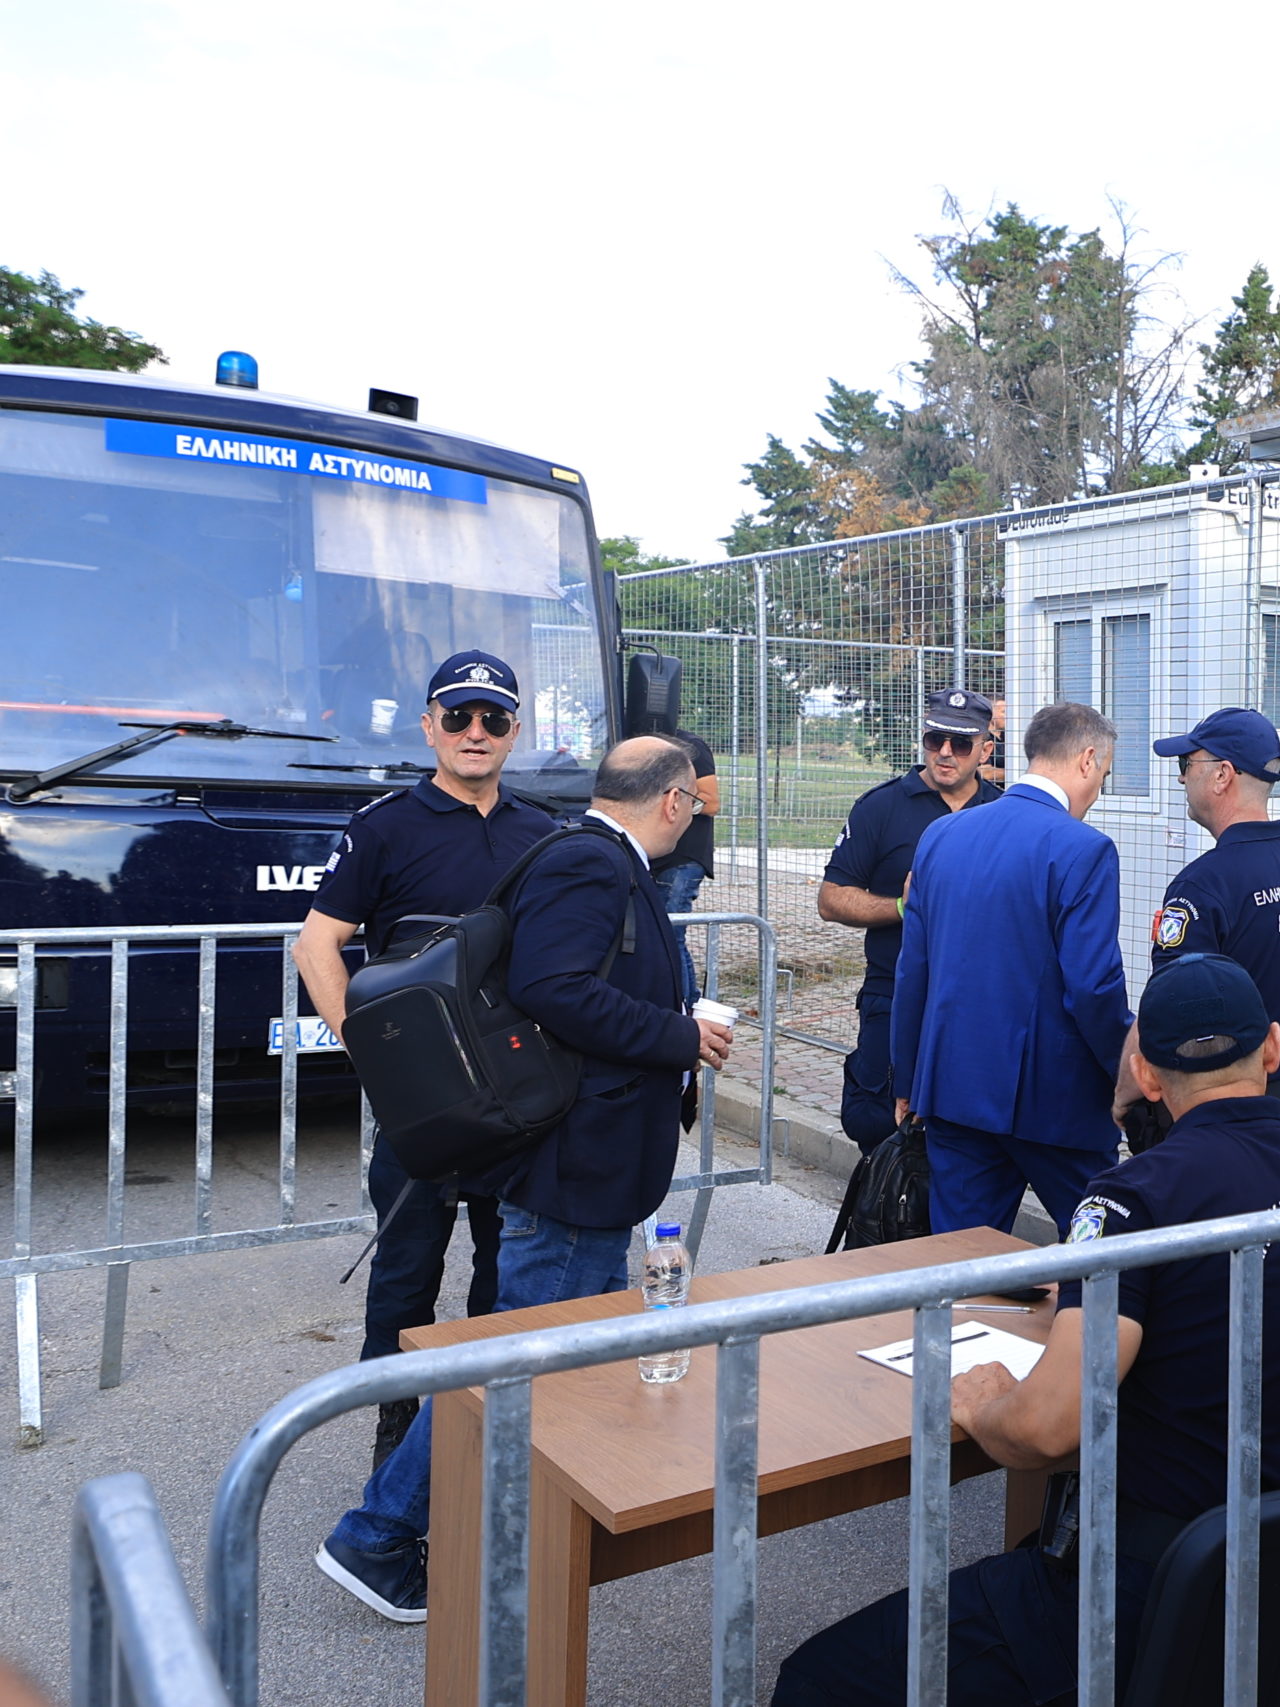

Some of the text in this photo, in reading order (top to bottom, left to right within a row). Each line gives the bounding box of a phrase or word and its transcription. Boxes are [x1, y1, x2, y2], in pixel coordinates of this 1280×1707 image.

[176, 434, 433, 491] ΕΛΛΗΝΙΚΗ ΑΣΤΥΝΟΜΙΑ
[256, 865, 327, 892] IVE
